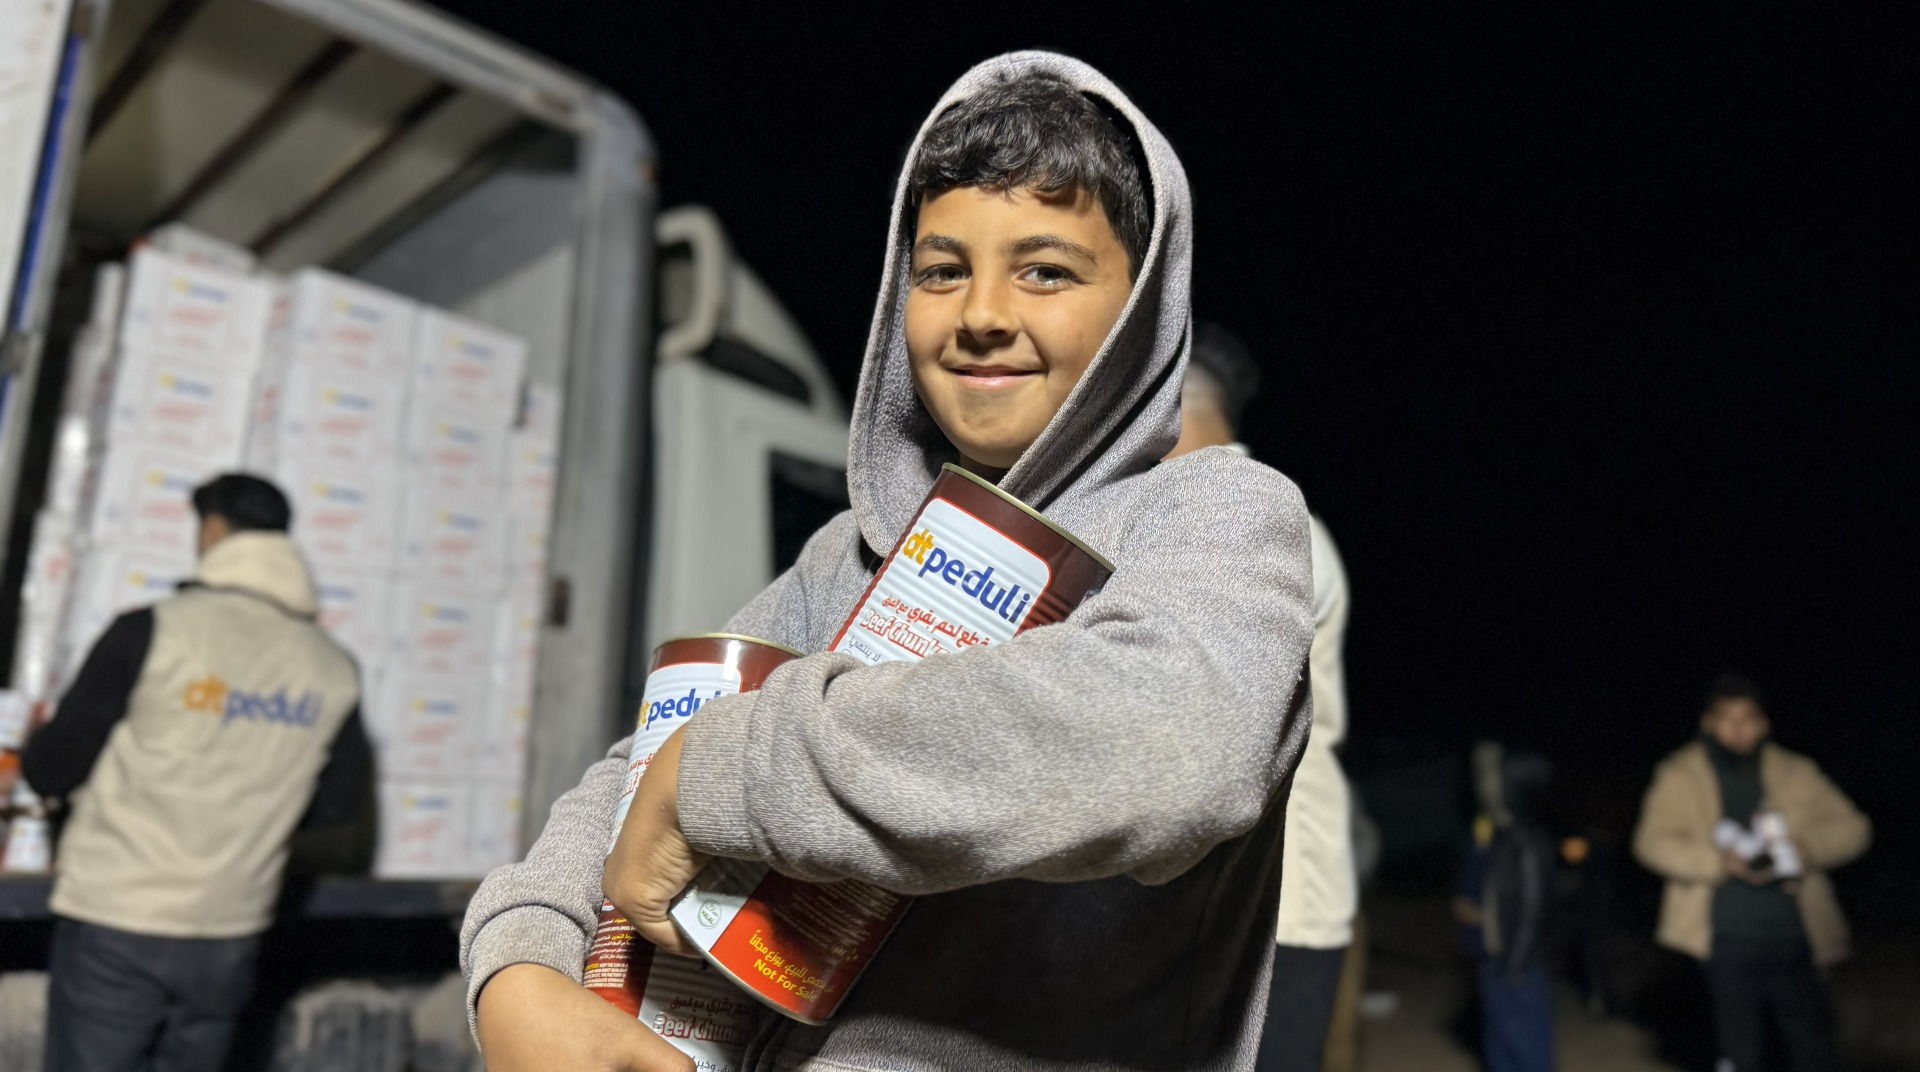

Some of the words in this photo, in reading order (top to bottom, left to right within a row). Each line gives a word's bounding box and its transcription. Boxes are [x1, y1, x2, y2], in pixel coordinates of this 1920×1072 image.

[903, 529, 1031, 624] dtpeduli
[860, 608, 895, 637] Beef
[907, 608, 936, 629] بقري
[931, 621, 963, 638] لحم
[753, 958, 777, 980] Not
[776, 974, 798, 991] For
[795, 985, 817, 1002] Sale
[653, 1013, 696, 1038] Beef
